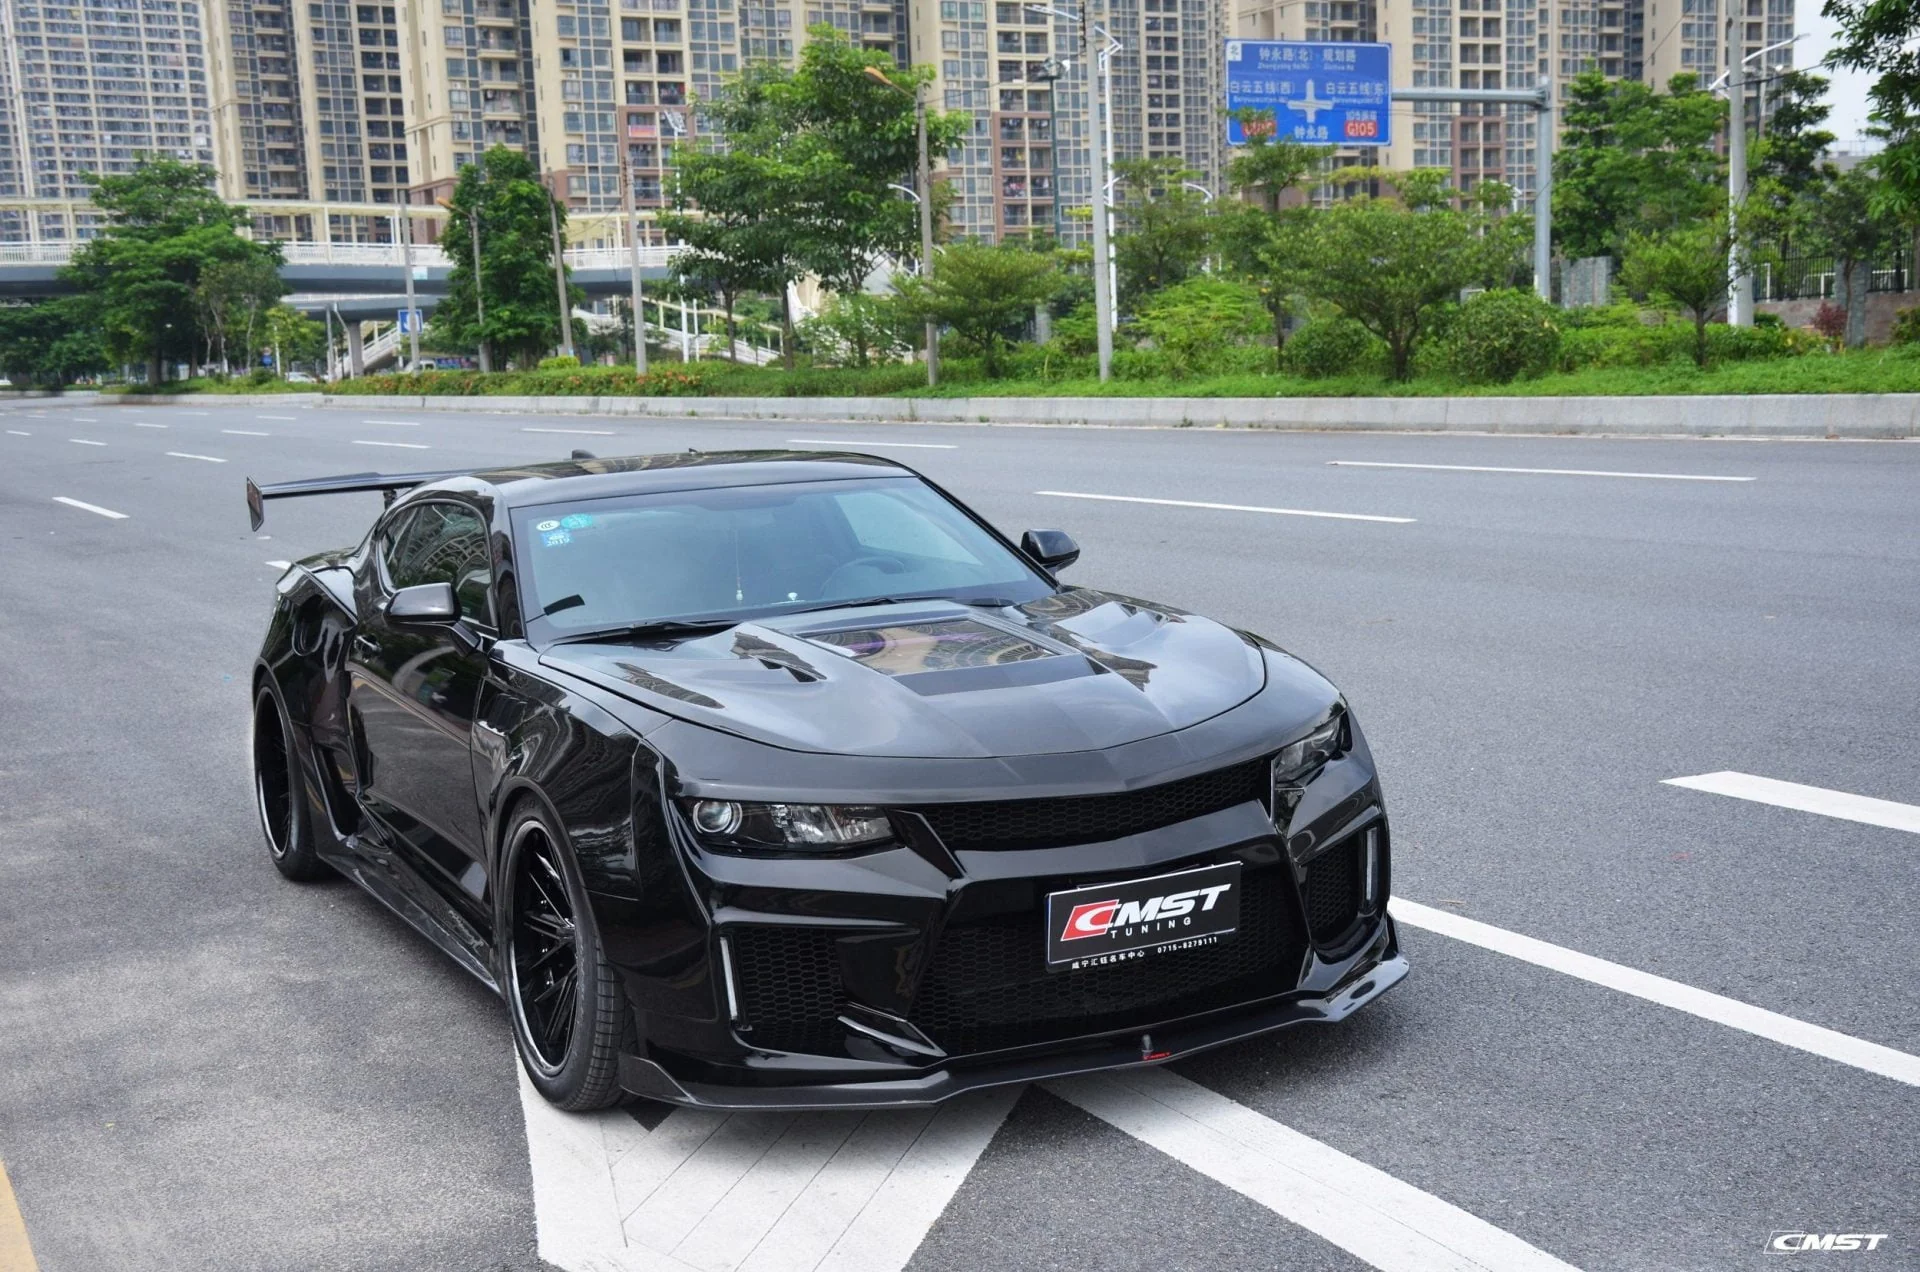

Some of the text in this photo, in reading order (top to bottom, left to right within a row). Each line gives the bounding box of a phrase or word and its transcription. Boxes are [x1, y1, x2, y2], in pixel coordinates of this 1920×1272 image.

[1294, 125, 1328, 140] 钟永路
[1347, 122, 1375, 136] G105
[1074, 883, 1231, 932] CMST
[1110, 916, 1191, 939] TUNING
